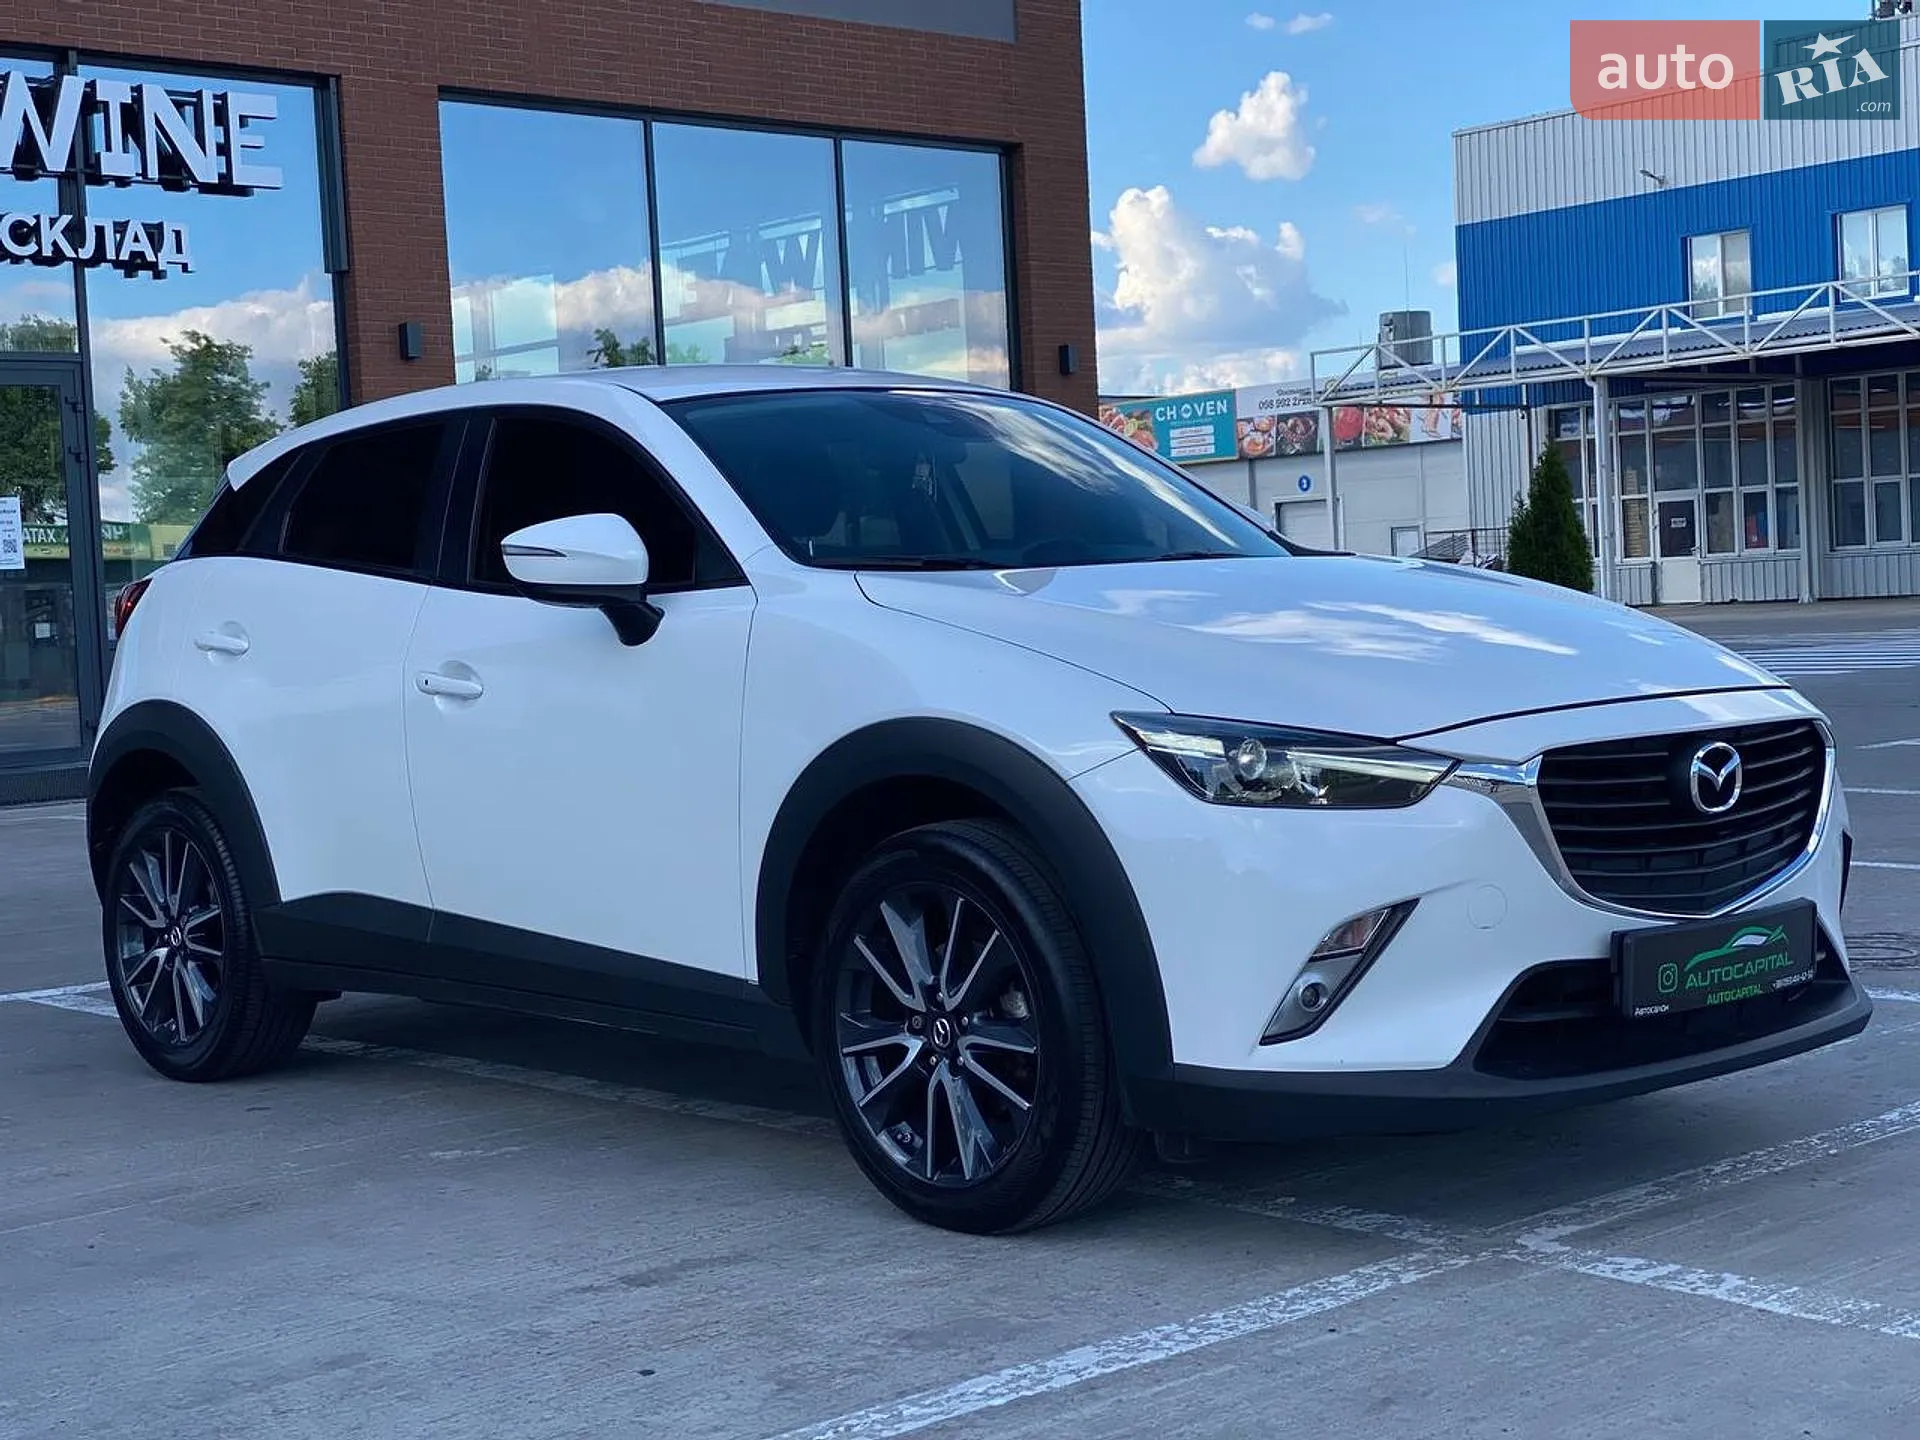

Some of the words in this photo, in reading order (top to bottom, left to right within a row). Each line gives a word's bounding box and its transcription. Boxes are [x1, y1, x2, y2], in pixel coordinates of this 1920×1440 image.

[0, 212, 193, 272] СКЛАД
[1685, 951, 1794, 990] AUTOCAPITAL
[1706, 984, 1763, 1006] AUTOCAPITAL
